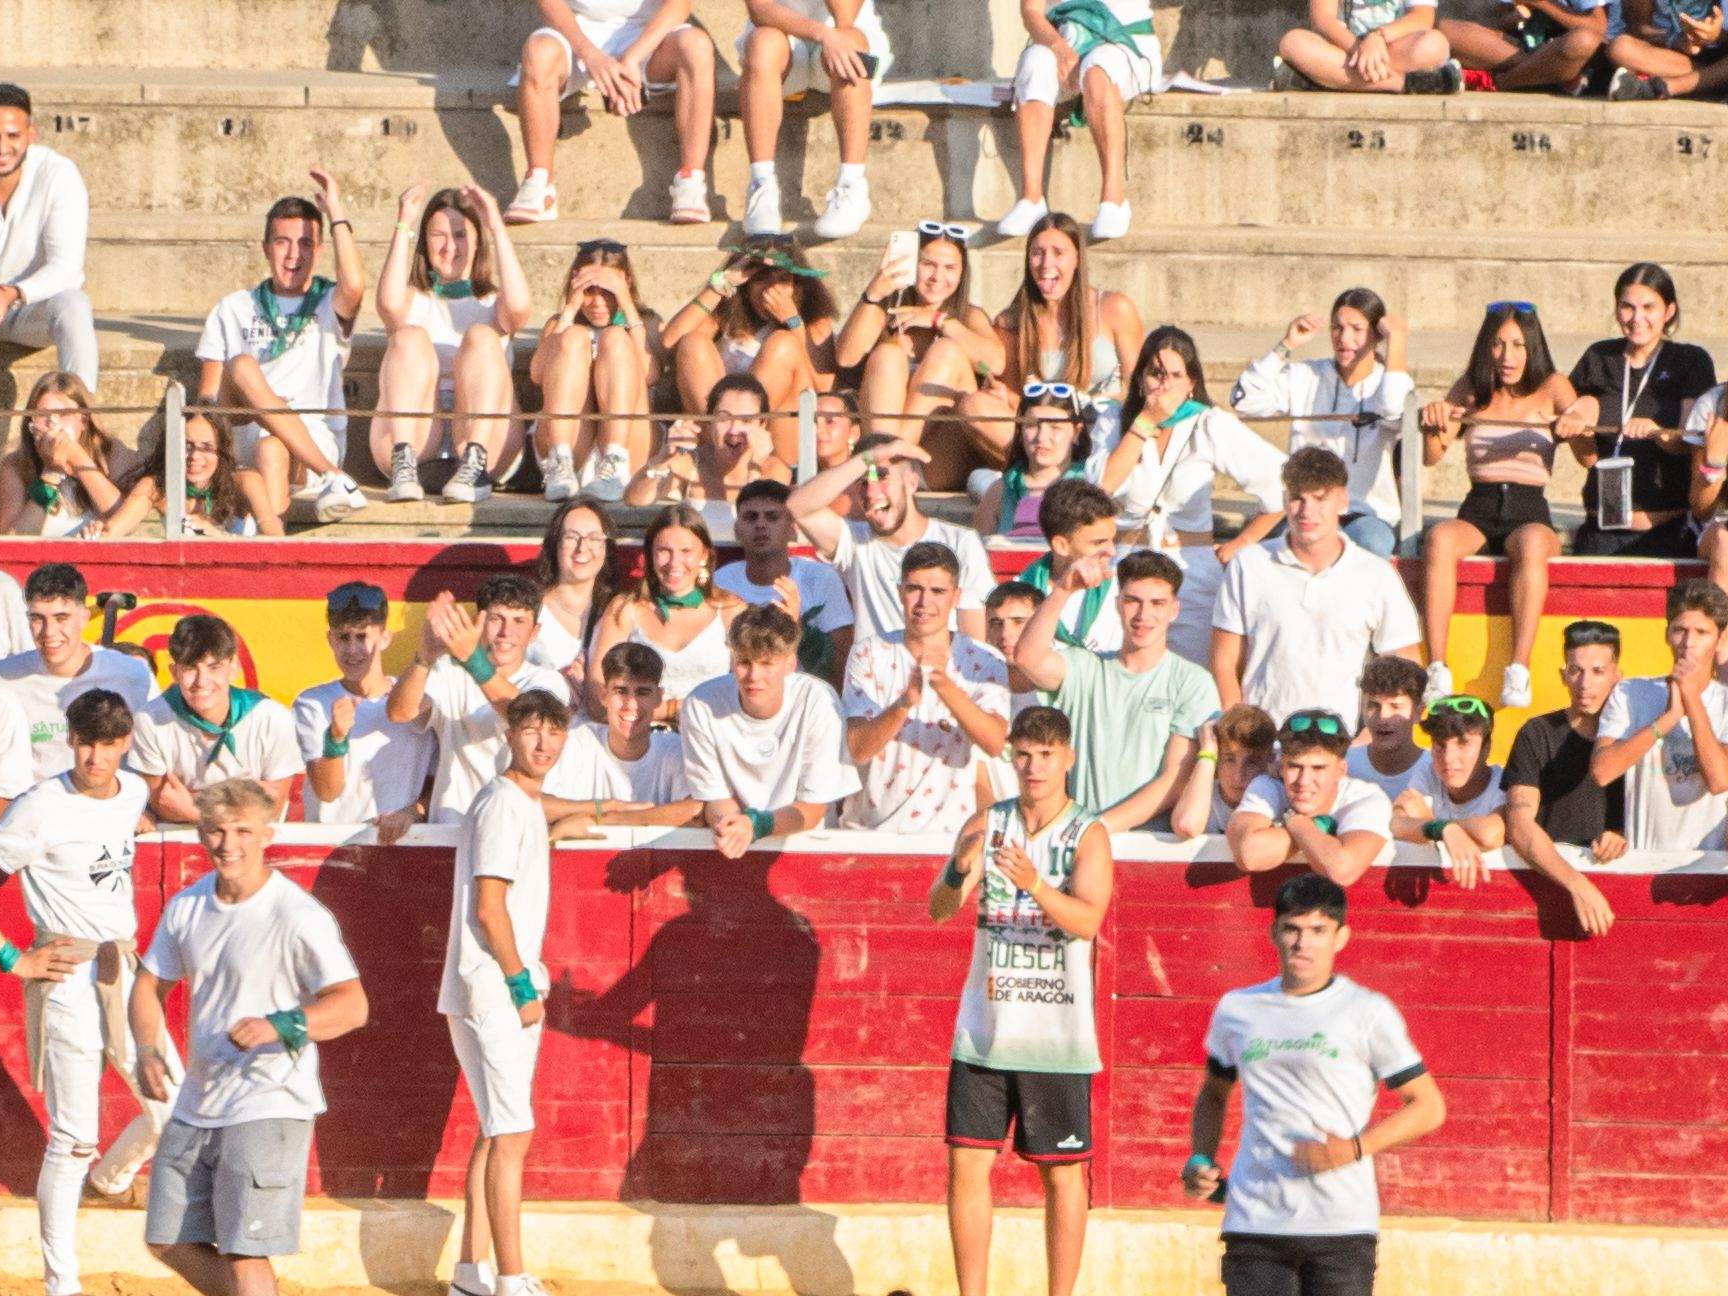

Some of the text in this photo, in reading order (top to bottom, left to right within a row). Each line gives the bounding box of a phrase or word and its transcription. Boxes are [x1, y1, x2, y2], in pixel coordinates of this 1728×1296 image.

[995, 976, 1065, 990] GOBIERNO
[995, 990, 1075, 1005] DE ARAGÓN
